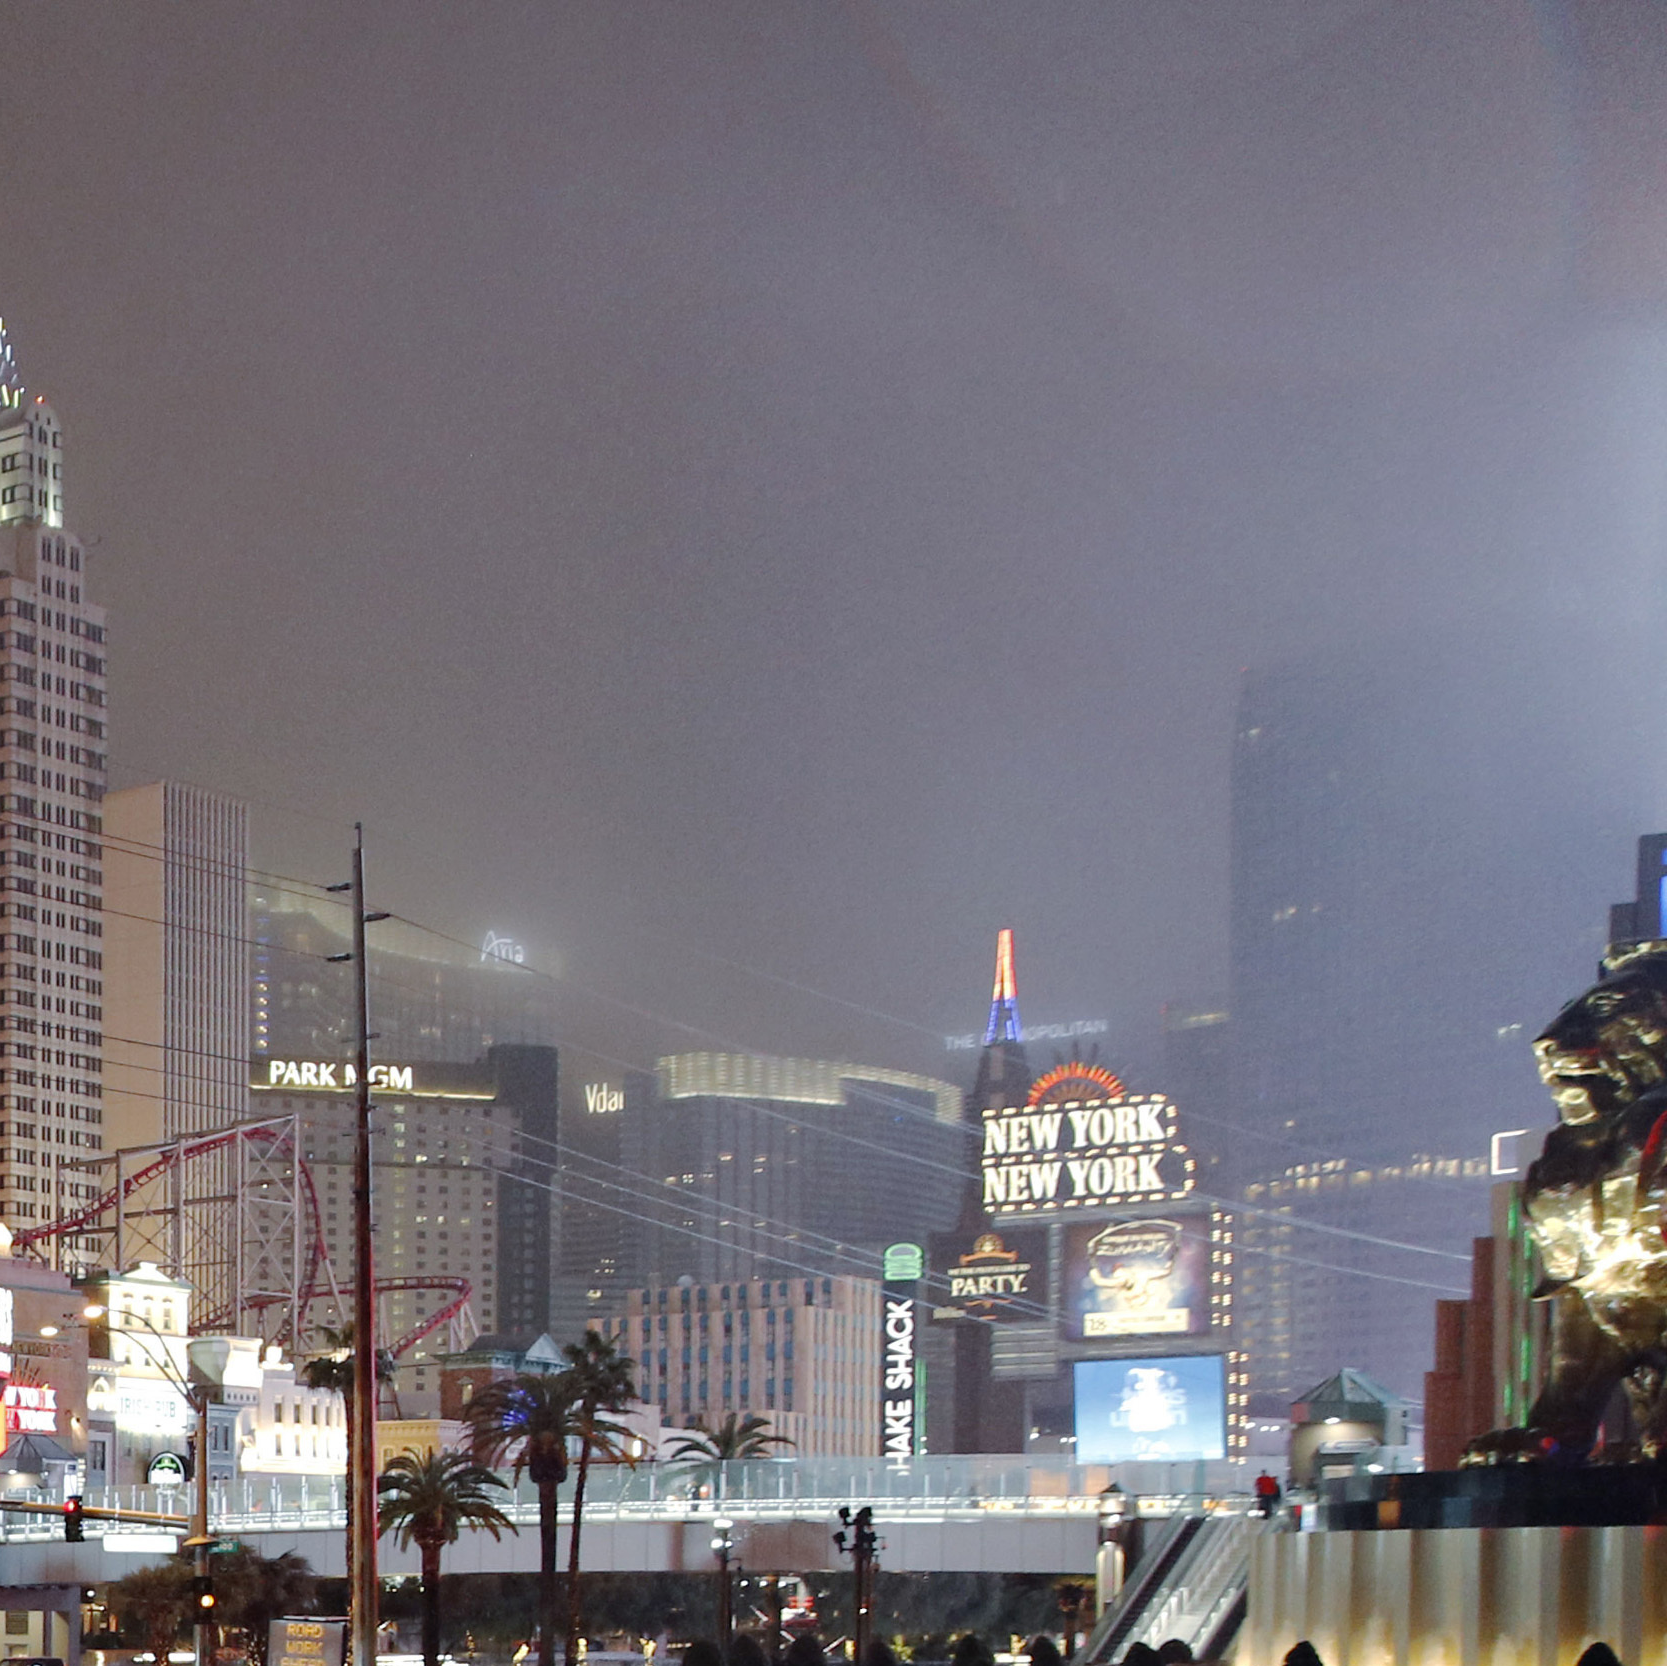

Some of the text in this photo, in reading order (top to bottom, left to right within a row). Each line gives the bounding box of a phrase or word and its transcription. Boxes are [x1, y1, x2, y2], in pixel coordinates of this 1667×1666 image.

[480, 929, 525, 963] Aria
[944, 1019, 1110, 1051] THE OPOLITAN
[269, 1060, 337, 1087] PARK
[982, 1103, 1167, 1156] NEW YORK
[982, 1153, 1166, 1204] NEW YORK
[950, 1273, 1029, 1298] PARTY.
[885, 1298, 914, 1390] SHACK
[286, 1623, 325, 1638] ROAD
[285, 1640, 324, 1655] WORK
